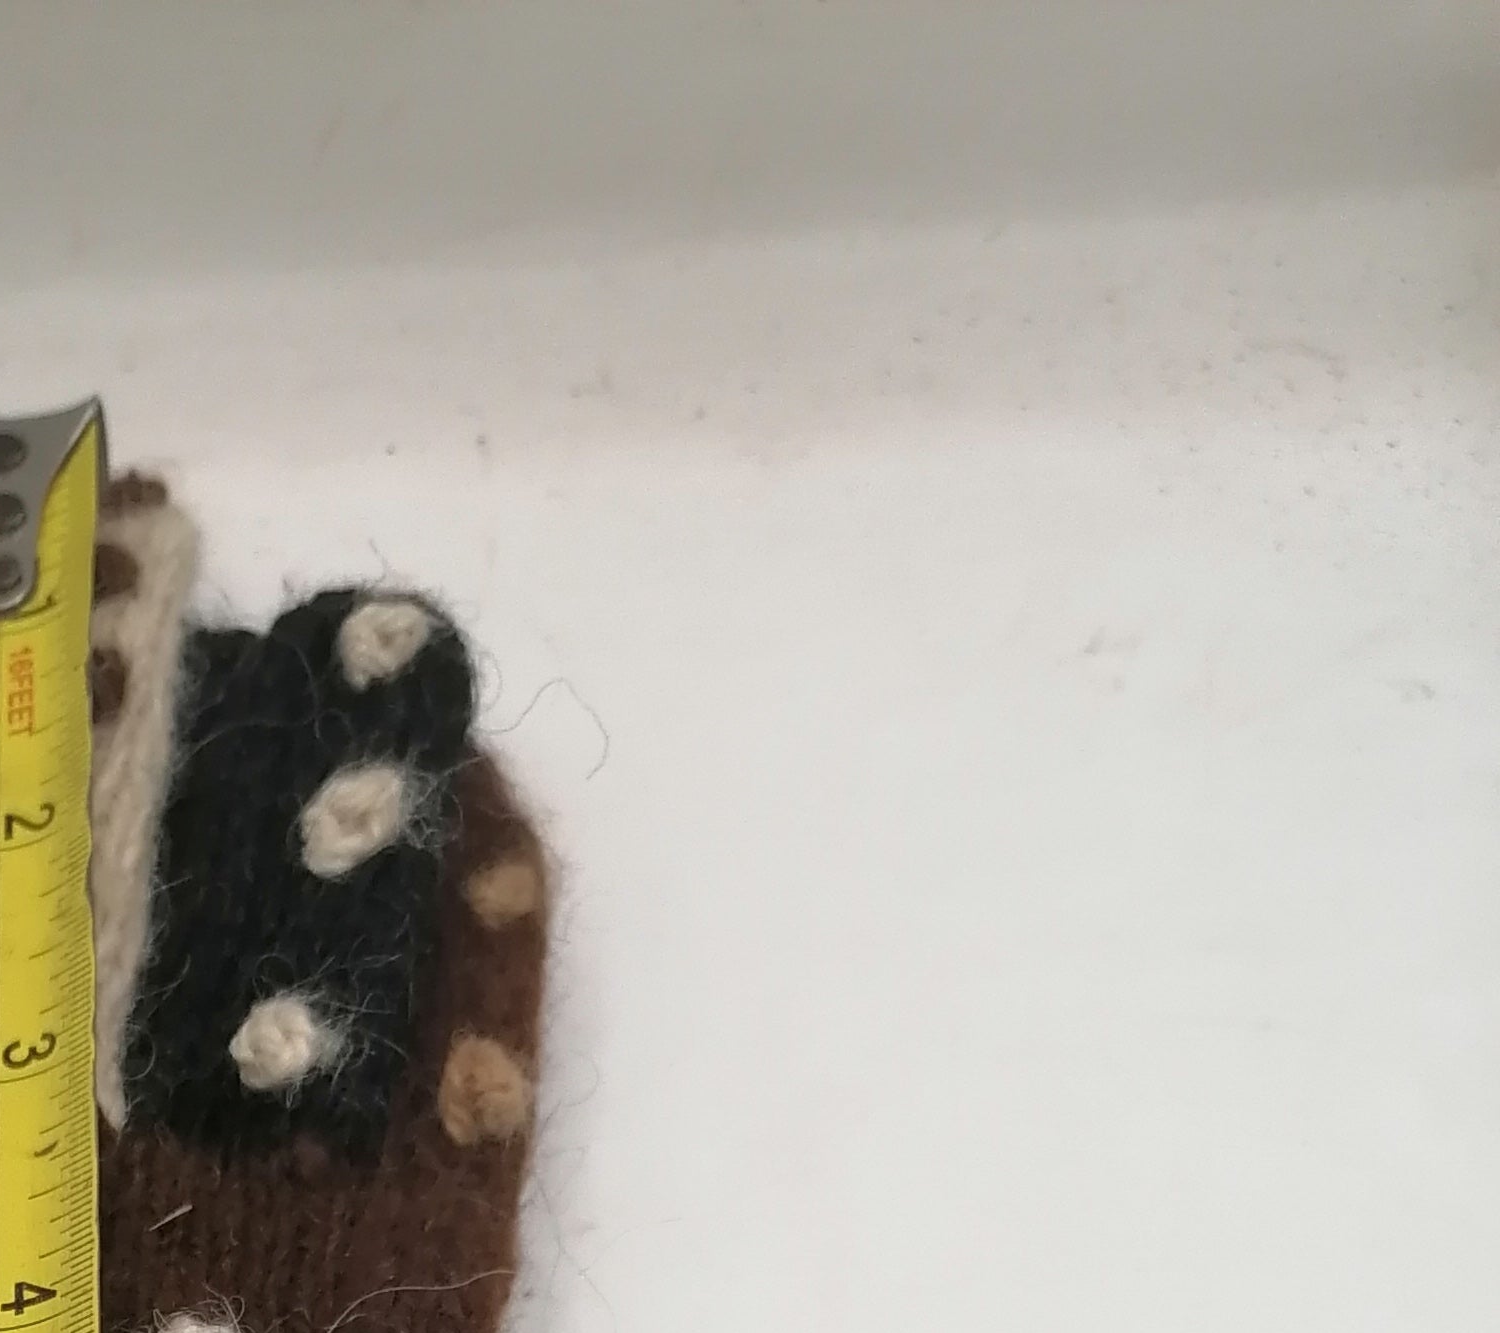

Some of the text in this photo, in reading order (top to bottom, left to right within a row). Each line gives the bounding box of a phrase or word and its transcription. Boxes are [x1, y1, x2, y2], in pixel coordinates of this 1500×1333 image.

[4, 803, 55, 840] 2
[2, 1032, 56, 1069] 3
[0, 1281, 57, 1315] 4
